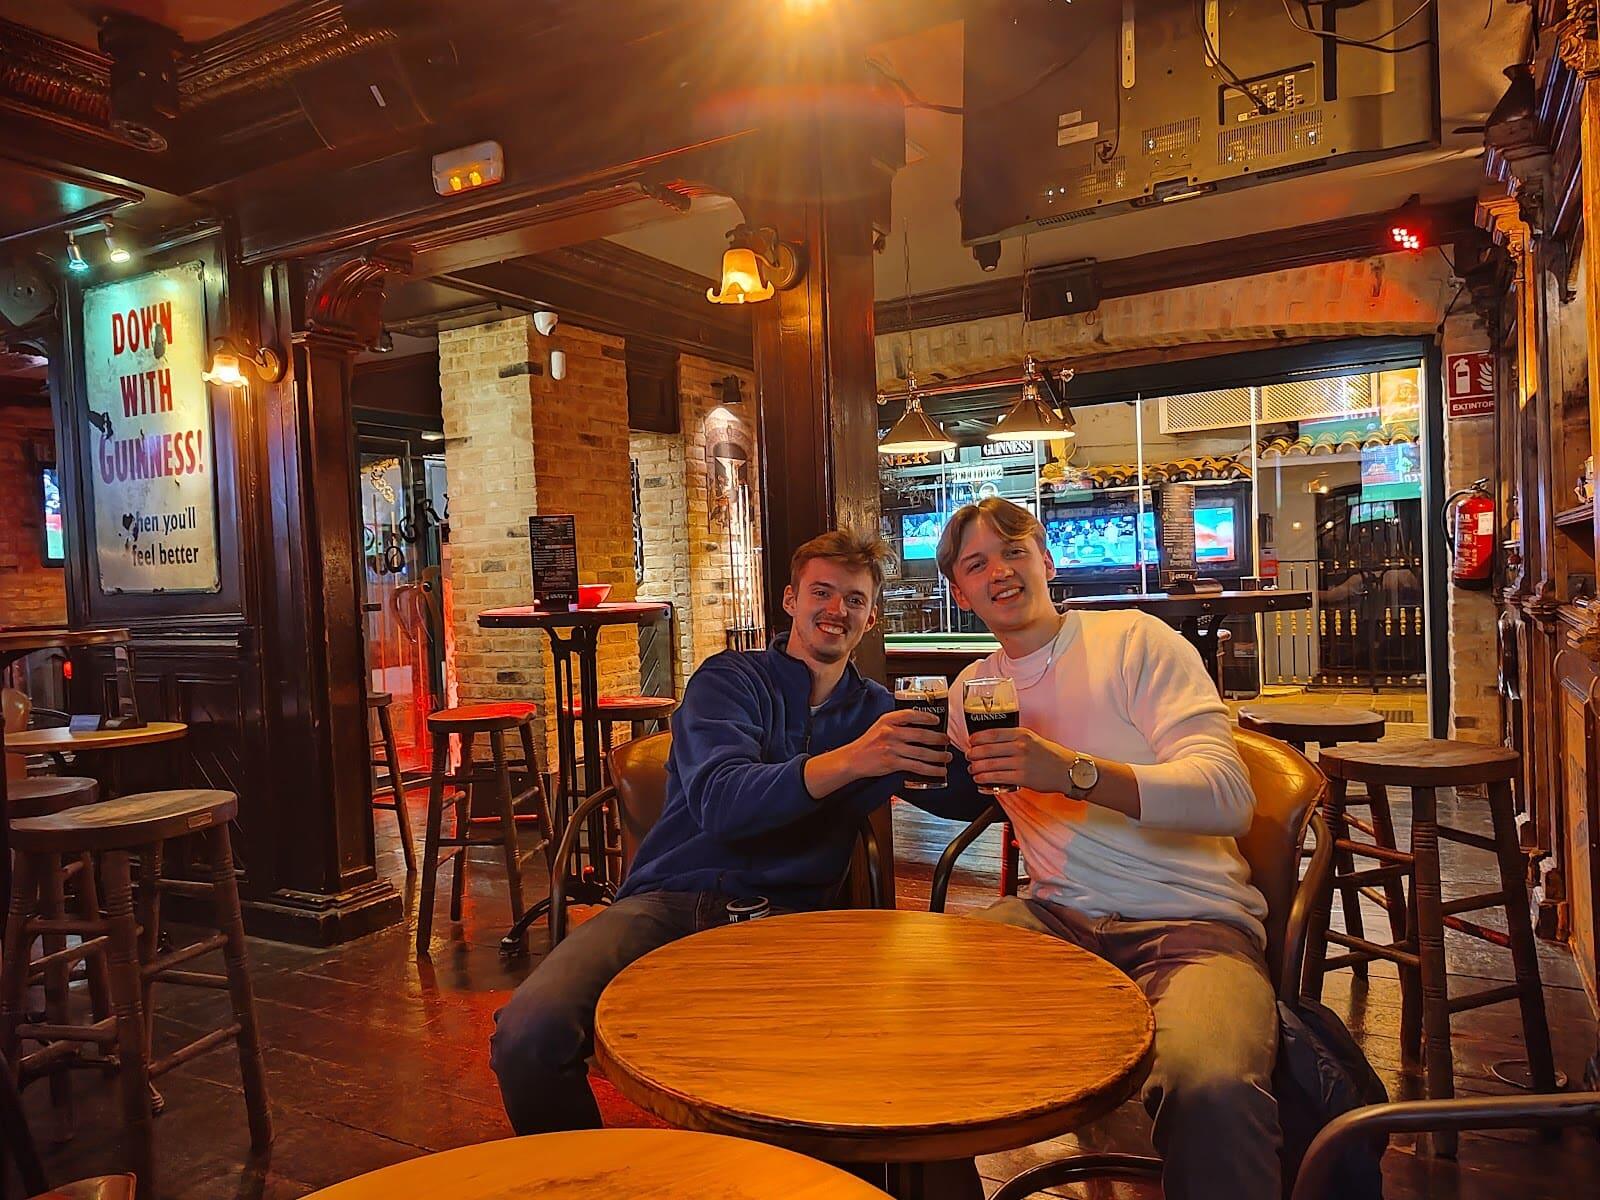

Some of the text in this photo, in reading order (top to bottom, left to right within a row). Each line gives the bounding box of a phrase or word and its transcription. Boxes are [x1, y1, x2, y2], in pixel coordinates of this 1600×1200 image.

[112, 301, 173, 357] DOWN
[120, 368, 173, 417] WITH
[100, 429, 204, 484] GUINNESS!
[983, 440, 1032, 456] GUINNESS
[163, 506, 196, 536] you'll
[132, 543, 199, 566] feel better
[970, 713, 1007, 722] GUINNESS
